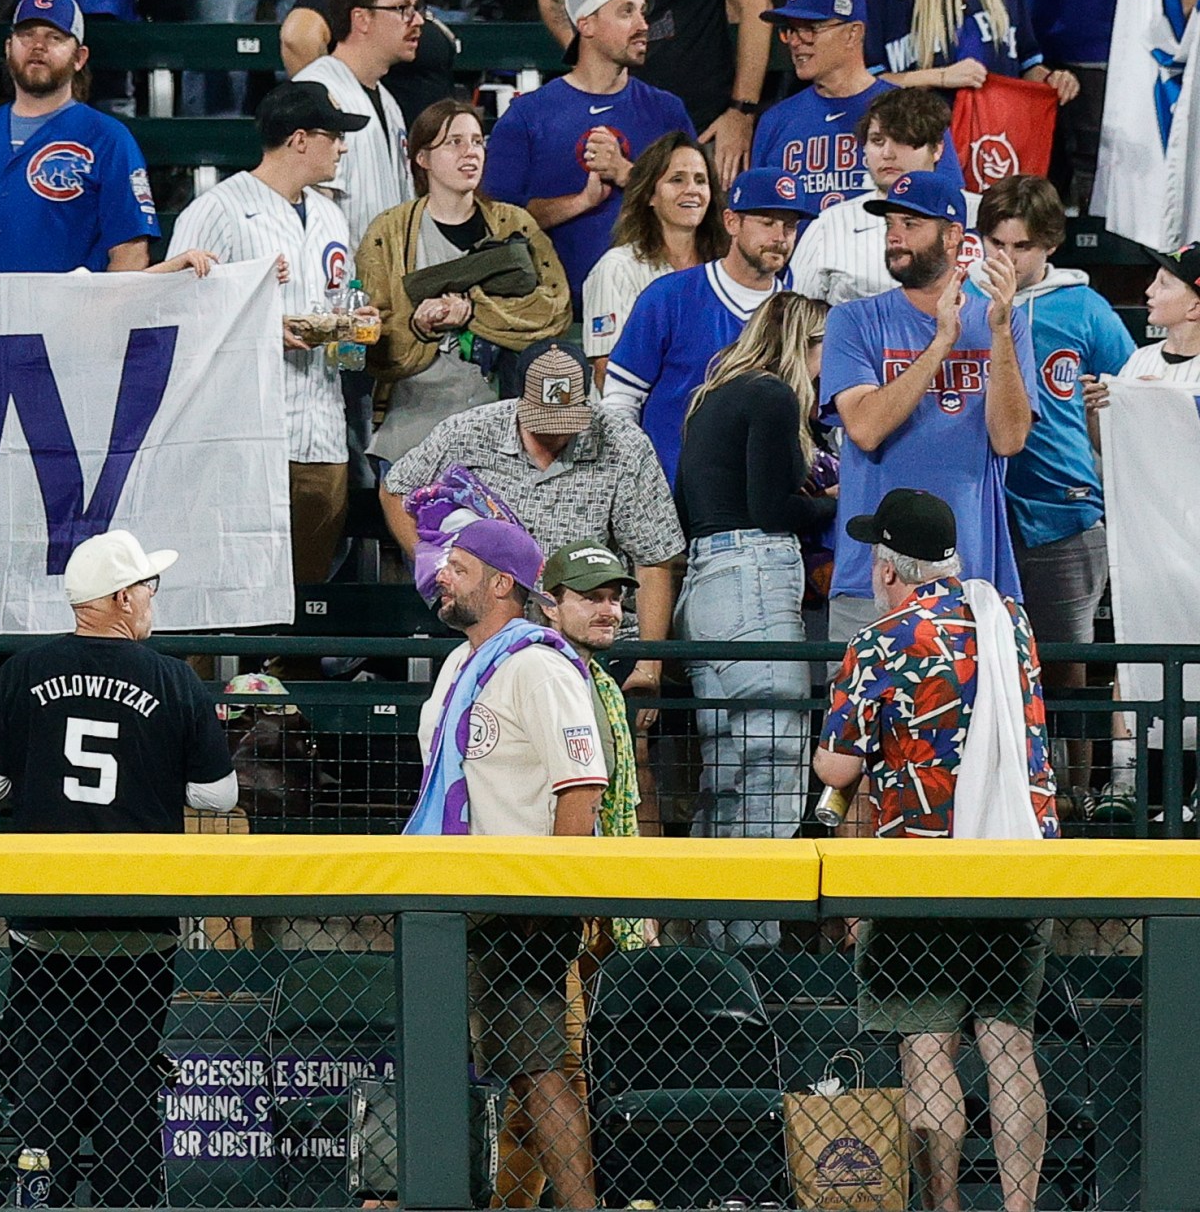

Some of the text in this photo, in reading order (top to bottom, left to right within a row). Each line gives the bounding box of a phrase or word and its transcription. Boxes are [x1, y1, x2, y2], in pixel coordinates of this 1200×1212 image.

[783, 133, 869, 176] CUB
[308, 602, 323, 614] 12
[31, 674, 160, 718] TULOWITZKI
[377, 705, 391, 714] 12
[474, 705, 496, 741] ROCKFORD
[63, 717, 119, 805] 5
[166, 1095, 250, 1126] UNNING,
[173, 1130, 202, 1157] OR
